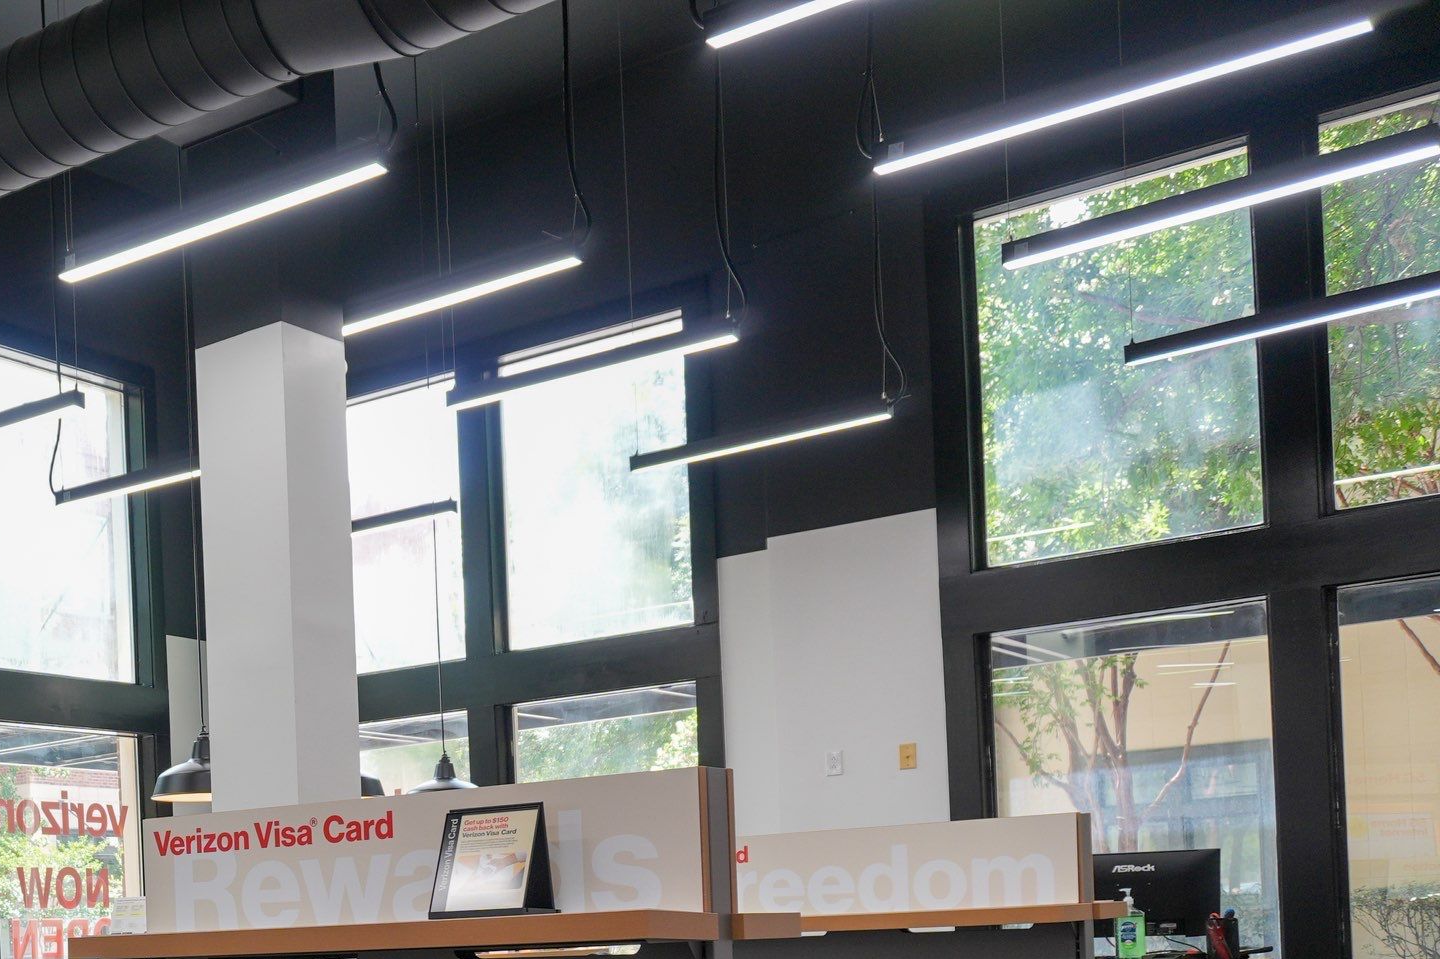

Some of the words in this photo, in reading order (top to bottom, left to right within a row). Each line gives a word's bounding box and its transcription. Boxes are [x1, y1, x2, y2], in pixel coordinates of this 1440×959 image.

[153, 827, 250, 857] Verizon
[323, 810, 394, 843] Card
[492, 816, 508, 824] $150
[174, 810, 662, 932] Rewads
[439, 858, 453, 891] Verizon
[447, 818, 459, 839] Card
[737, 843, 1056, 913] reedom
[1111, 863, 1156, 873] ASRock
